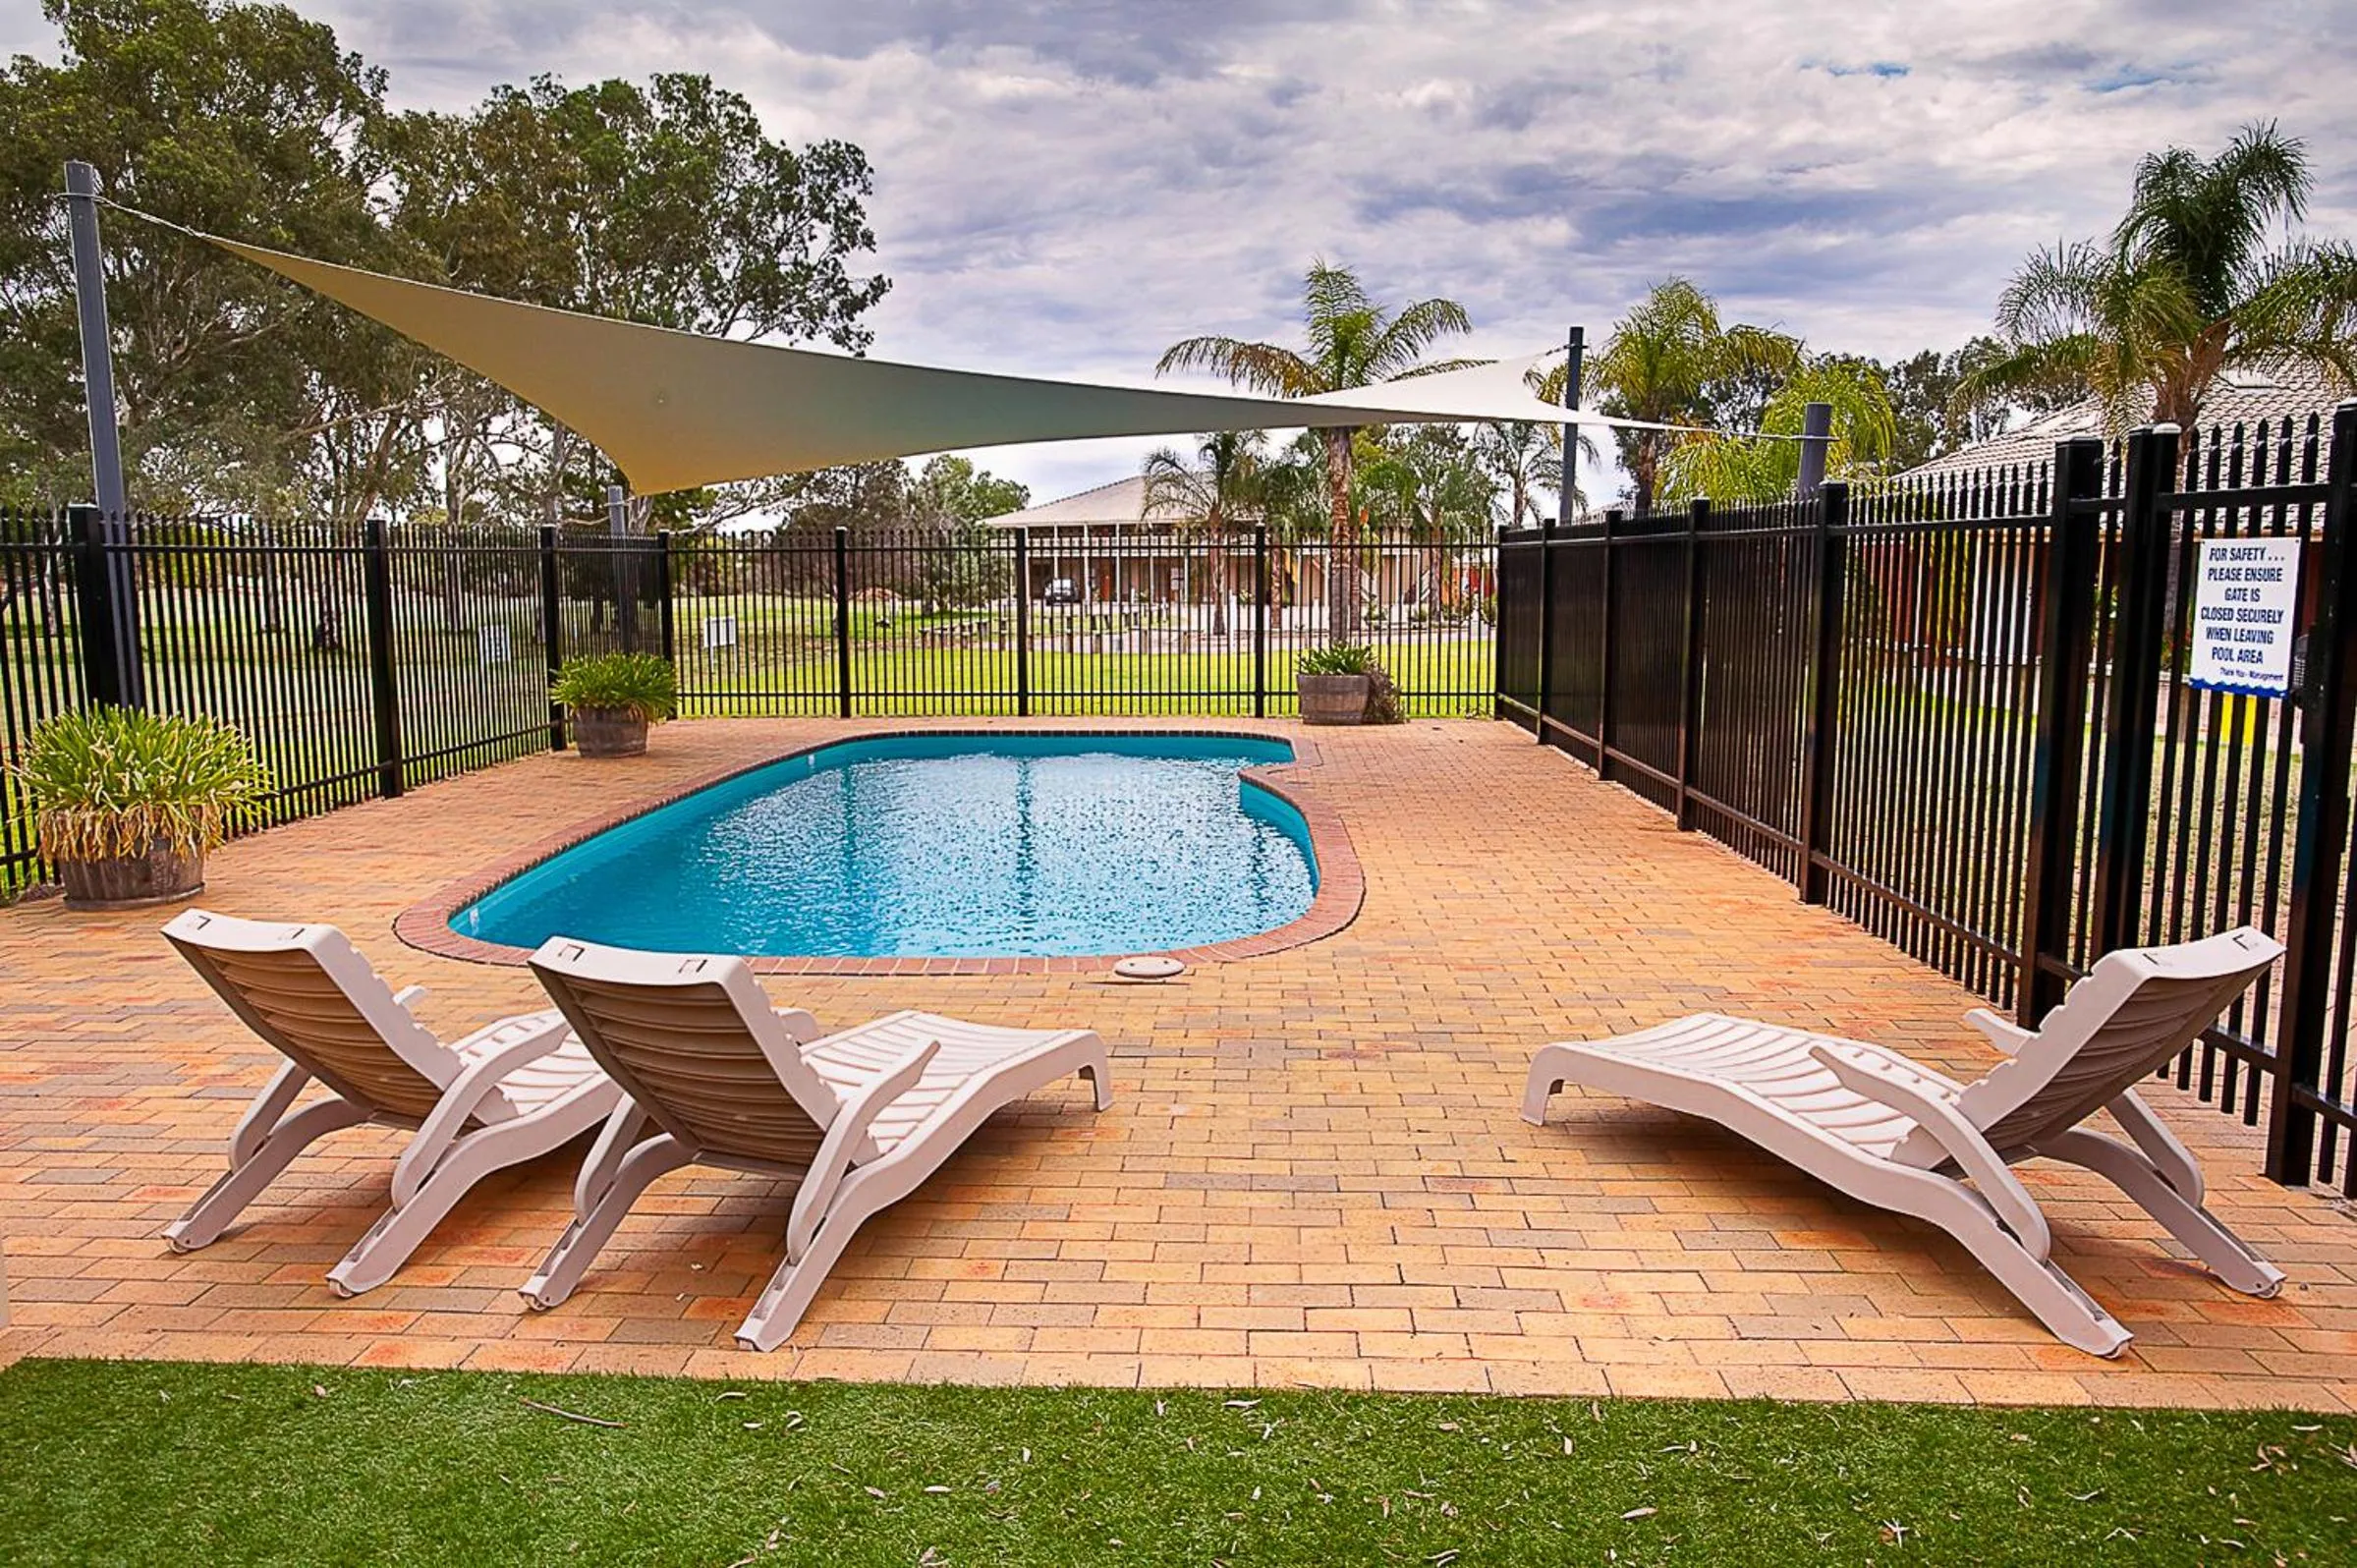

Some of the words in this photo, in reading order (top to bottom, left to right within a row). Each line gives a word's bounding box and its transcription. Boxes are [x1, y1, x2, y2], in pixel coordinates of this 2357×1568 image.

[2209, 547, 2227, 561] FOR
[2208, 568, 2242, 581] PLEASE
[2244, 568, 2282, 582] ENSURE
[2224, 588, 2248, 601] GATE
[2250, 588, 2261, 602] IS
[2201, 606, 2233, 621] CLOSED
[2236, 607, 2284, 624] SECURELY
[2206, 627, 2232, 642] WHEN
[2234, 628, 2274, 644] LEAVING
[2212, 646, 2234, 661] POOL
[2237, 648, 2264, 664] AREA
